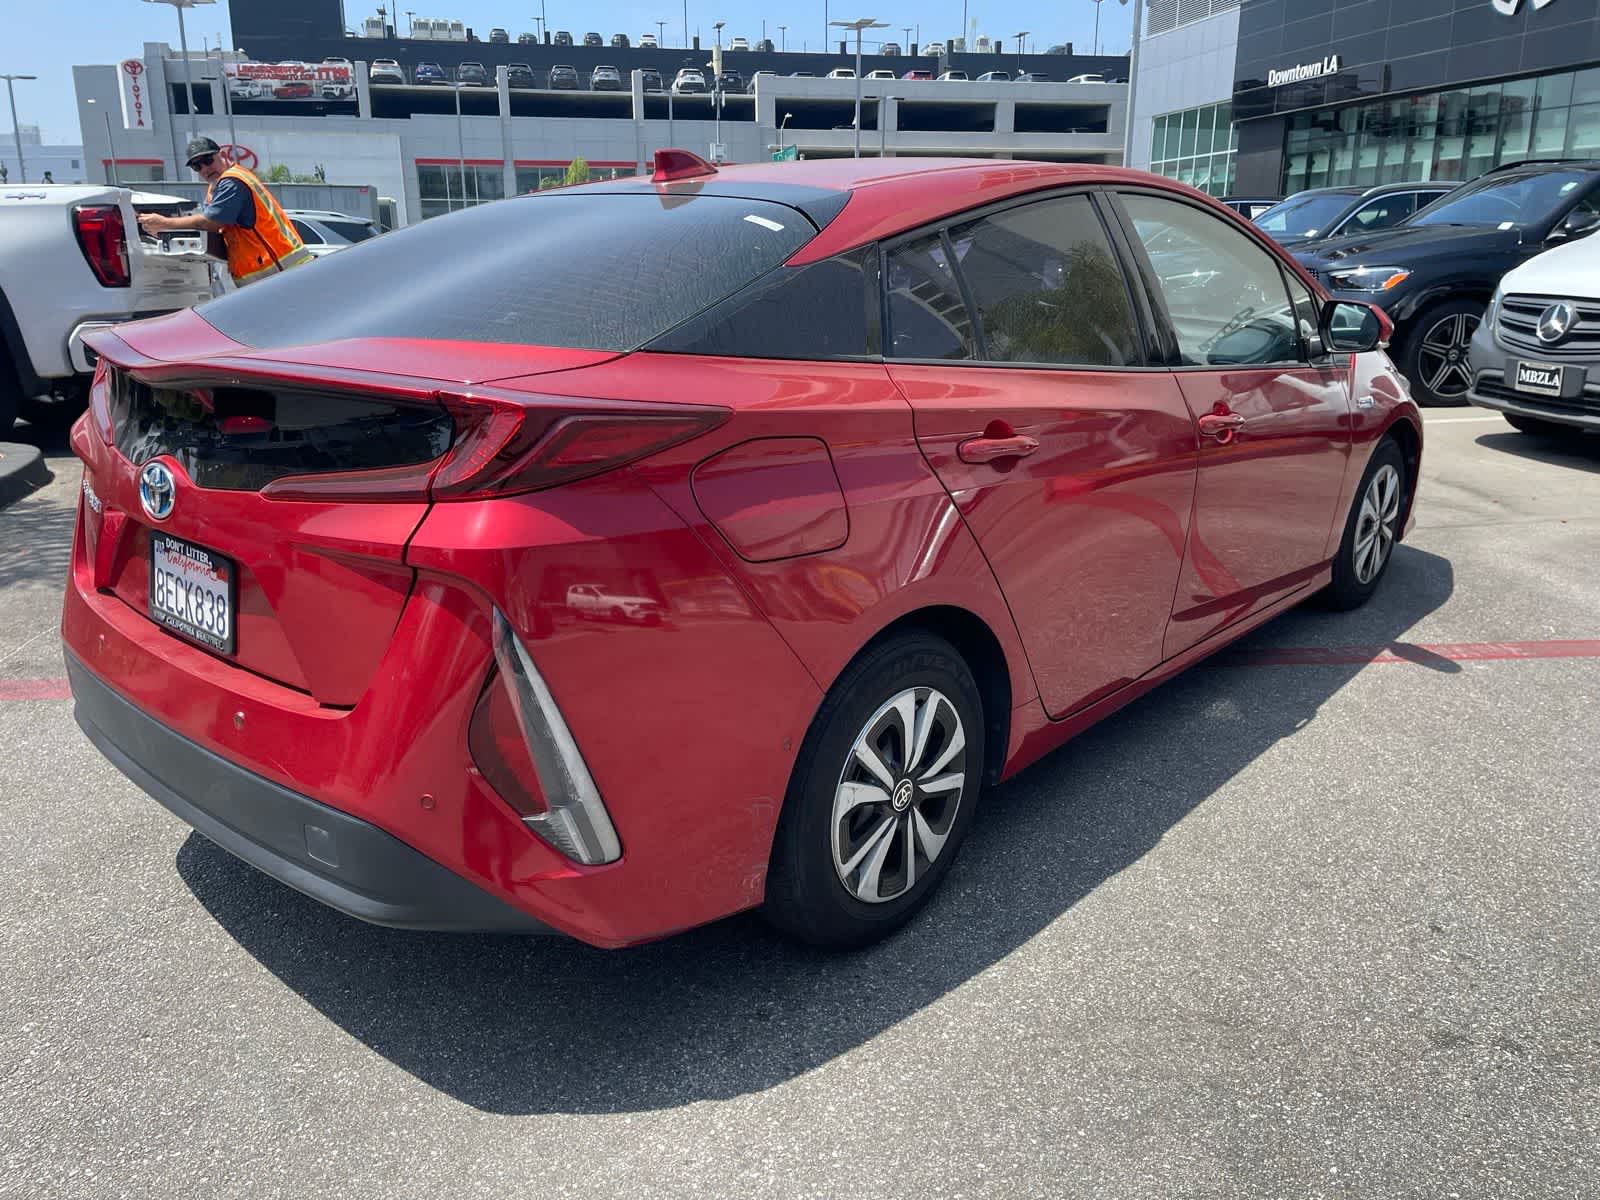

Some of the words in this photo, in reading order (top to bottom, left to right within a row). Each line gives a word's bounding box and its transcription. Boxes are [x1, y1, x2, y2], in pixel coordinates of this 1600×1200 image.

[1268, 62, 1322, 87] Downtown
[1323, 54, 1338, 75] LA
[131, 76, 144, 127] TOYOTA
[1519, 369, 1560, 387] MBZLA
[155, 567, 226, 636] 8ECK838
